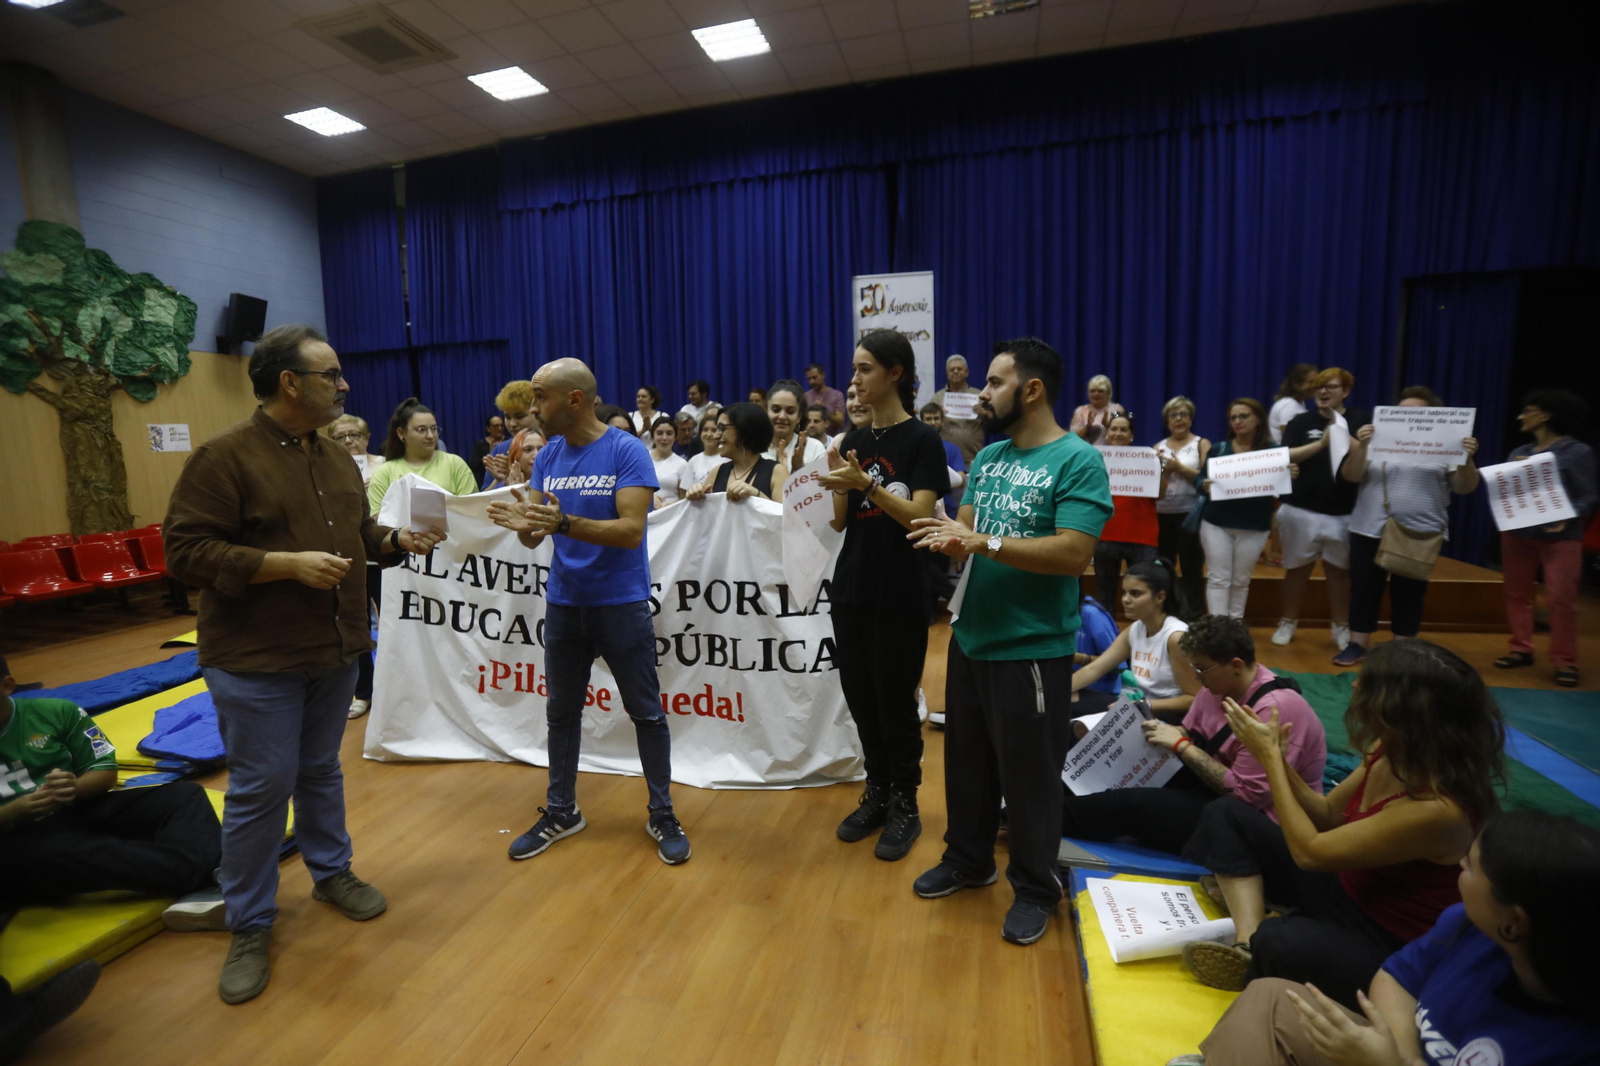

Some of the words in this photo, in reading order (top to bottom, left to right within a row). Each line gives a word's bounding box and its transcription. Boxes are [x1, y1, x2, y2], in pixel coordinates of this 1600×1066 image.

[1390, 408, 1426, 416] personal
[1115, 450, 1156, 459] recortes
[1237, 451, 1282, 462] recortes
[1373, 447, 1418, 455] compañera
[543, 475, 617, 491] AVERROES
[1110, 467, 1156, 477] pagamos
[1234, 465, 1285, 478] pagamos
[1226, 484, 1275, 495] nosotras
[1495, 470, 1515, 519] suficientes
[1513, 475, 1528, 509] medios
[1541, 461, 1562, 510] Educación
[1534, 500, 1547, 513] sin
[675, 579, 768, 616] POR
[775, 578, 833, 618] LA
[654, 622, 840, 673] PÚBLICA
[478, 659, 550, 698] ¡Pila
[1134, 666, 1152, 678] TEA
[1063, 762, 1071, 772] El
[1071, 735, 1101, 766] personal
[1099, 711, 1121, 738] laboral
[1120, 703, 1130, 715] no
[1070, 757, 1096, 781] somos
[1094, 737, 1117, 759] trapos
[1115, 728, 1125, 738] de
[1123, 712, 1138, 730] usar
[1104, 759, 1111, 768] y
[1110, 745, 1124, 762] tirar
[1132, 763, 1142, 774] de
[1141, 756, 1149, 766] la
[1138, 752, 1170, 786] trasladada
[1161, 891, 1181, 918] somos
[1176, 892, 1188, 902] El
[1102, 886, 1128, 933] compañera
[1126, 907, 1144, 935] Vuelta
[1178, 901, 1200, 925] perso
